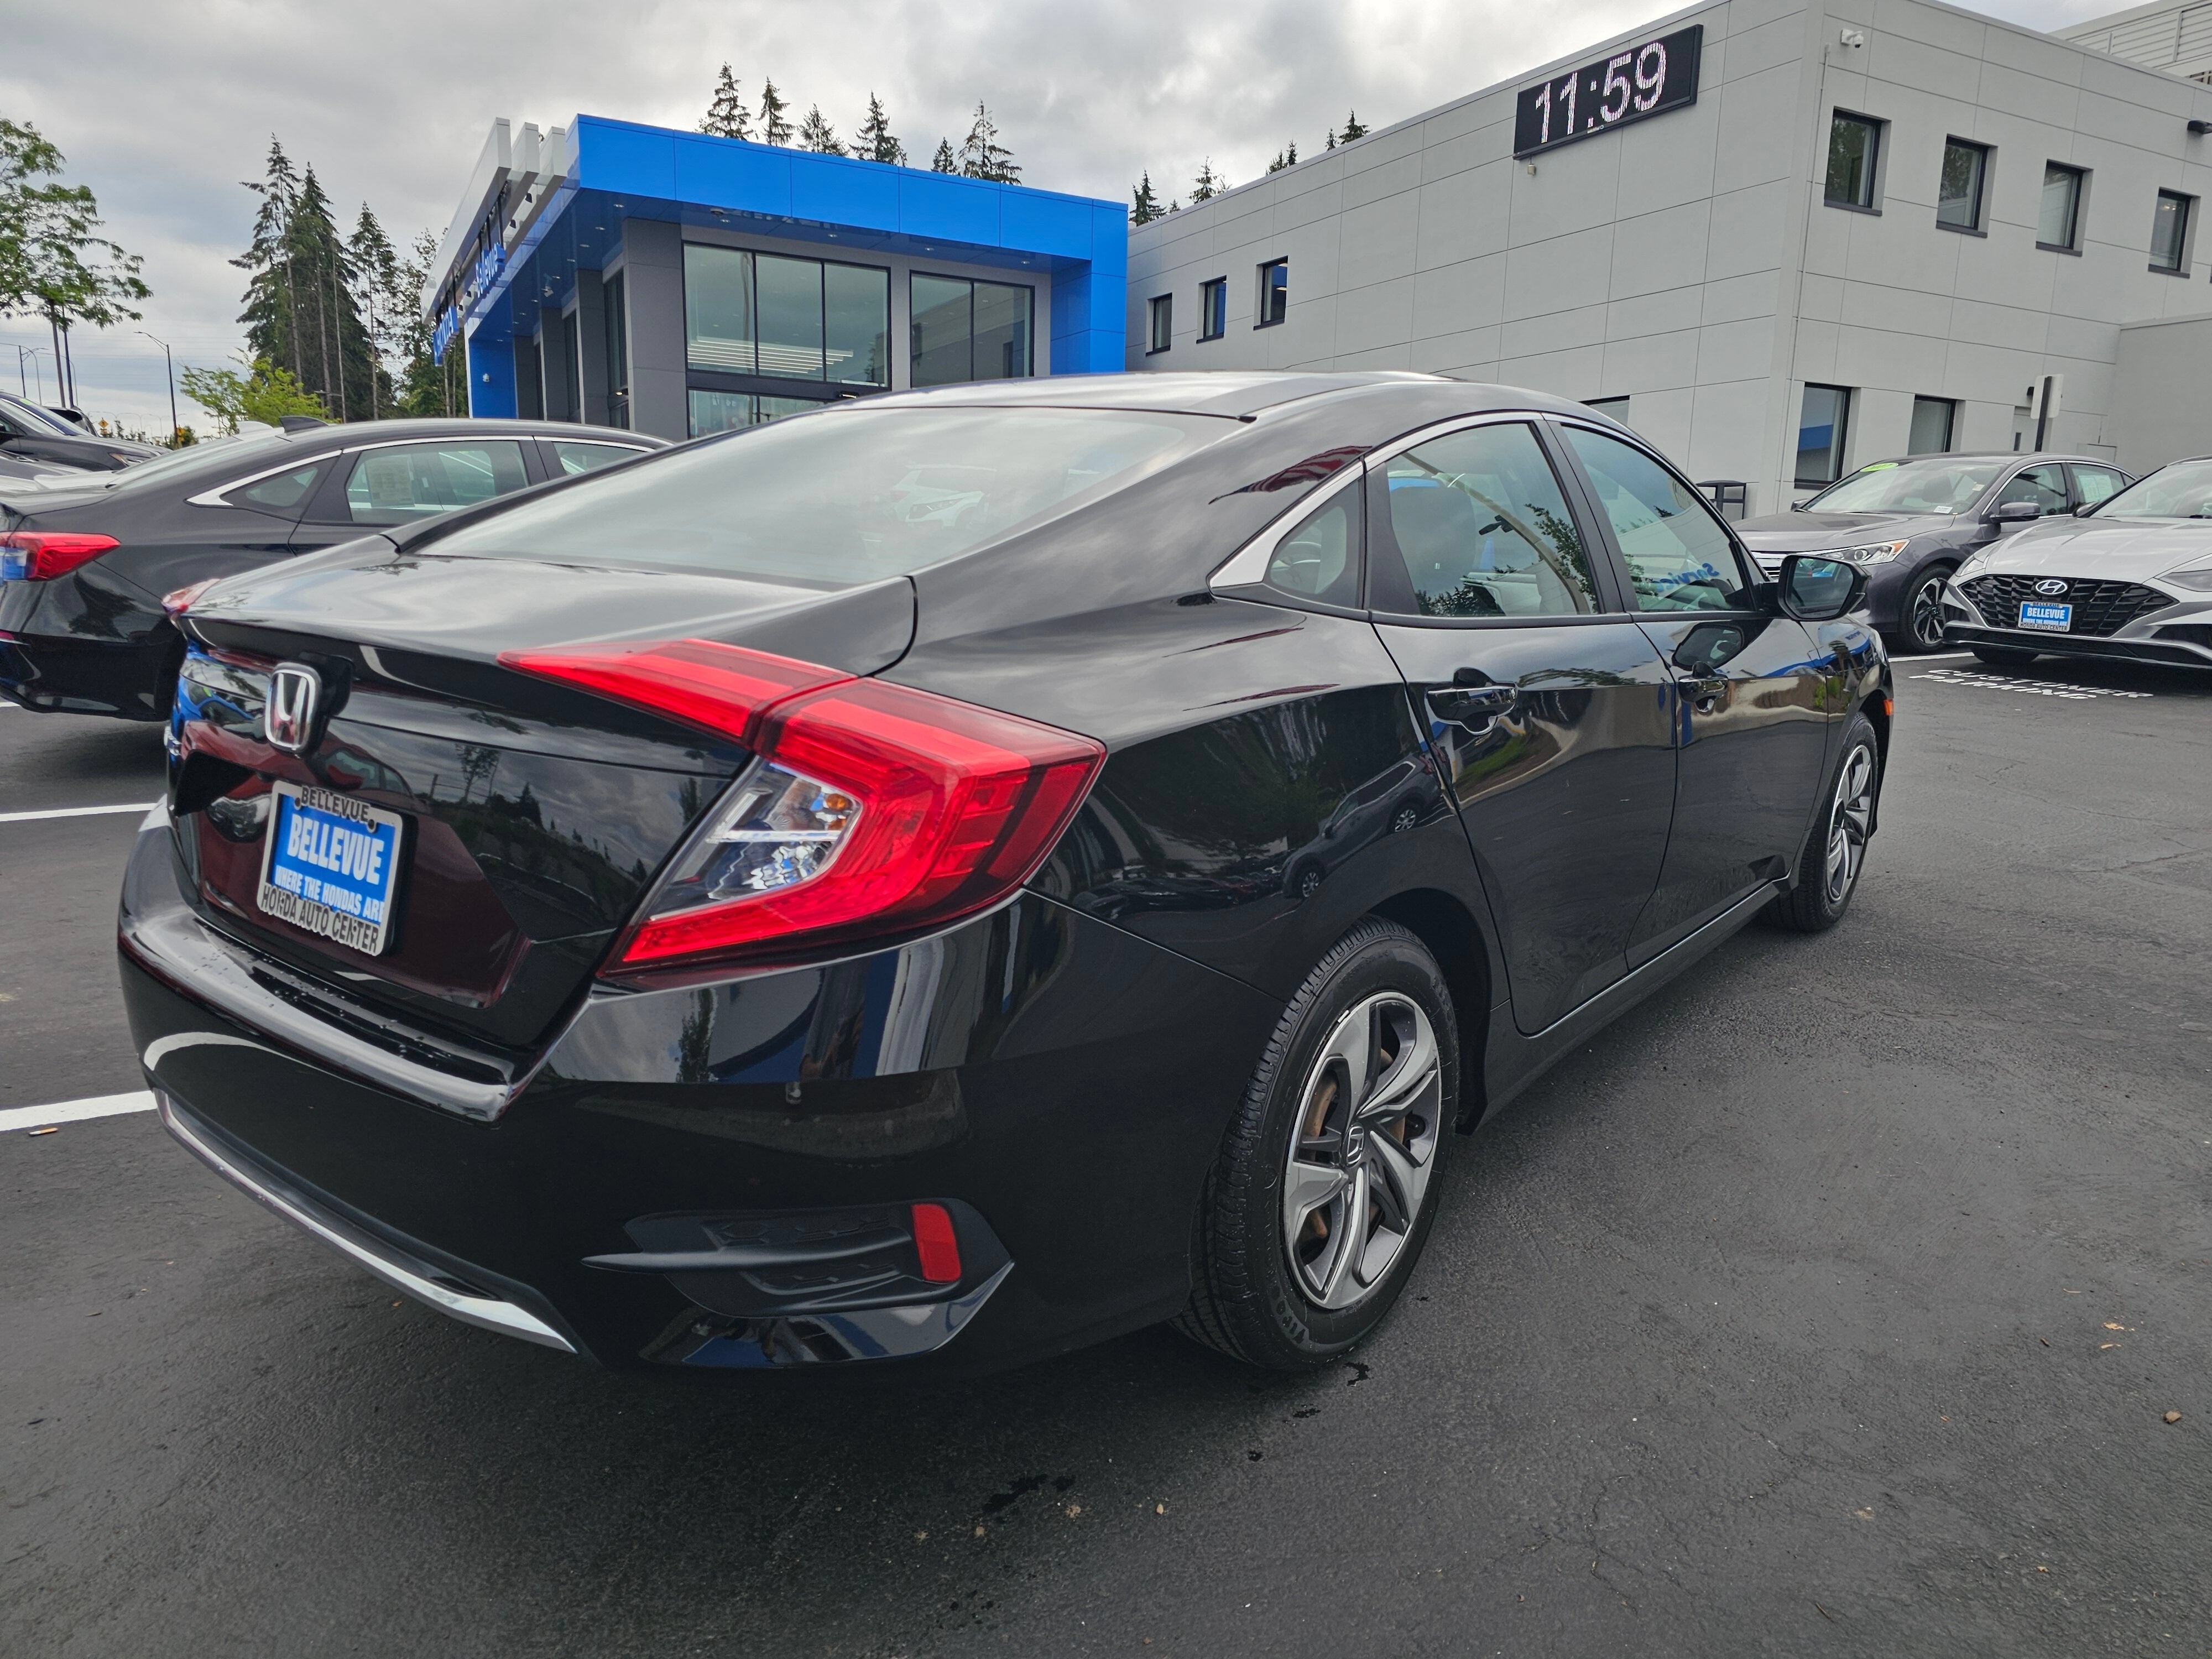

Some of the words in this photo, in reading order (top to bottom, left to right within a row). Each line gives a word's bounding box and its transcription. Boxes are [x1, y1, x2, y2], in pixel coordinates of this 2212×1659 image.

[1535, 41, 1667, 143] 11:59
[2027, 607, 2065, 619] BELLEVUE
[1908, 675, 2097, 700] PARKING
[1928, 669, 2154, 698] CUSTOMER
[301, 786, 370, 822] BELLEVUE
[287, 813, 385, 885] BELLEVUE
[275, 865, 303, 894] WHERE
[304, 875, 321, 901] THE
[322, 882, 363, 915] HONDAS
[262, 885, 297, 921] HONDA
[299, 900, 330, 934] AUTO
[332, 914, 379, 953] CENTER
